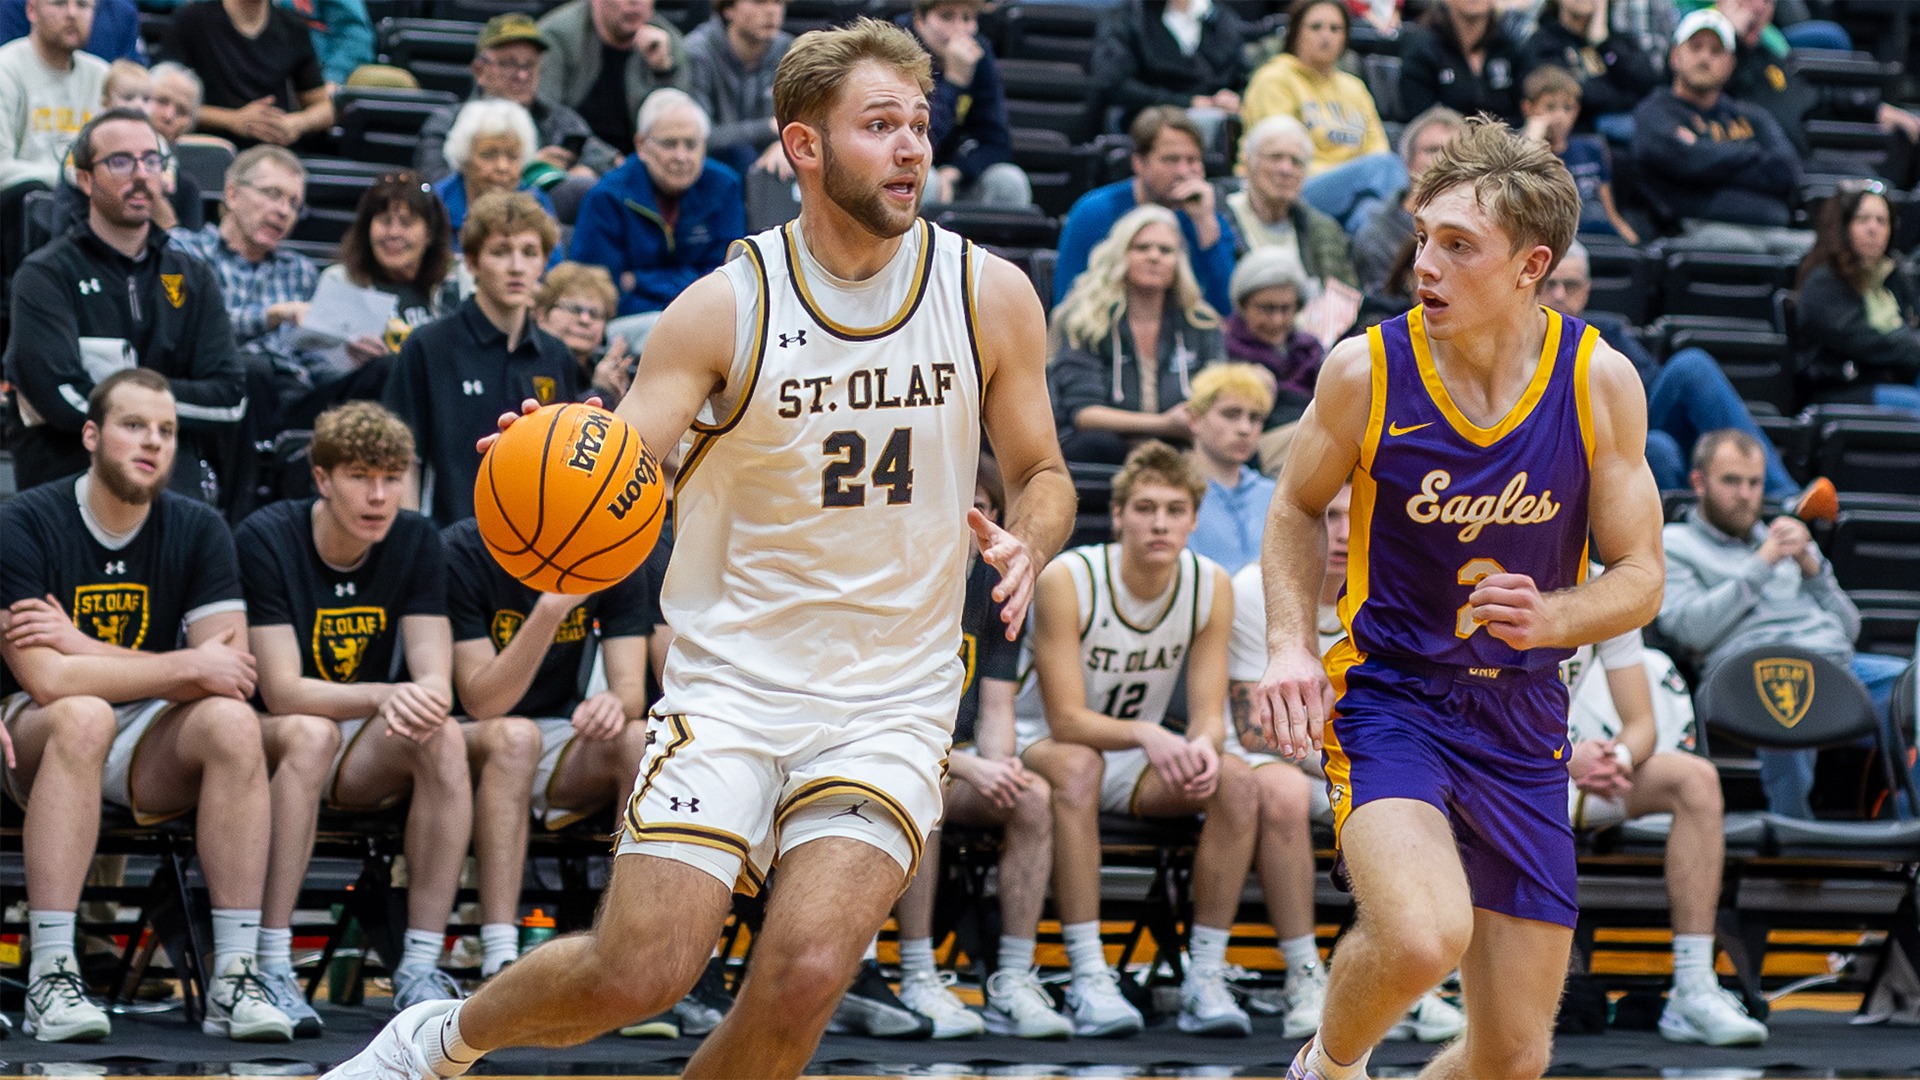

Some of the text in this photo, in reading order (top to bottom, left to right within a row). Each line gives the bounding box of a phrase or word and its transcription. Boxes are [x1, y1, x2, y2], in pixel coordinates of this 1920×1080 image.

[778, 362, 956, 418] ST. OLAF
[567, 410, 613, 473] NCAA
[821, 426, 914, 509] 24
[1406, 469, 1561, 543] Eagles
[81, 592, 139, 614] ST. OLAF
[336, 615, 377, 635] OLAF
[1087, 646, 1119, 672] ST.
[1102, 681, 1149, 719] 12
